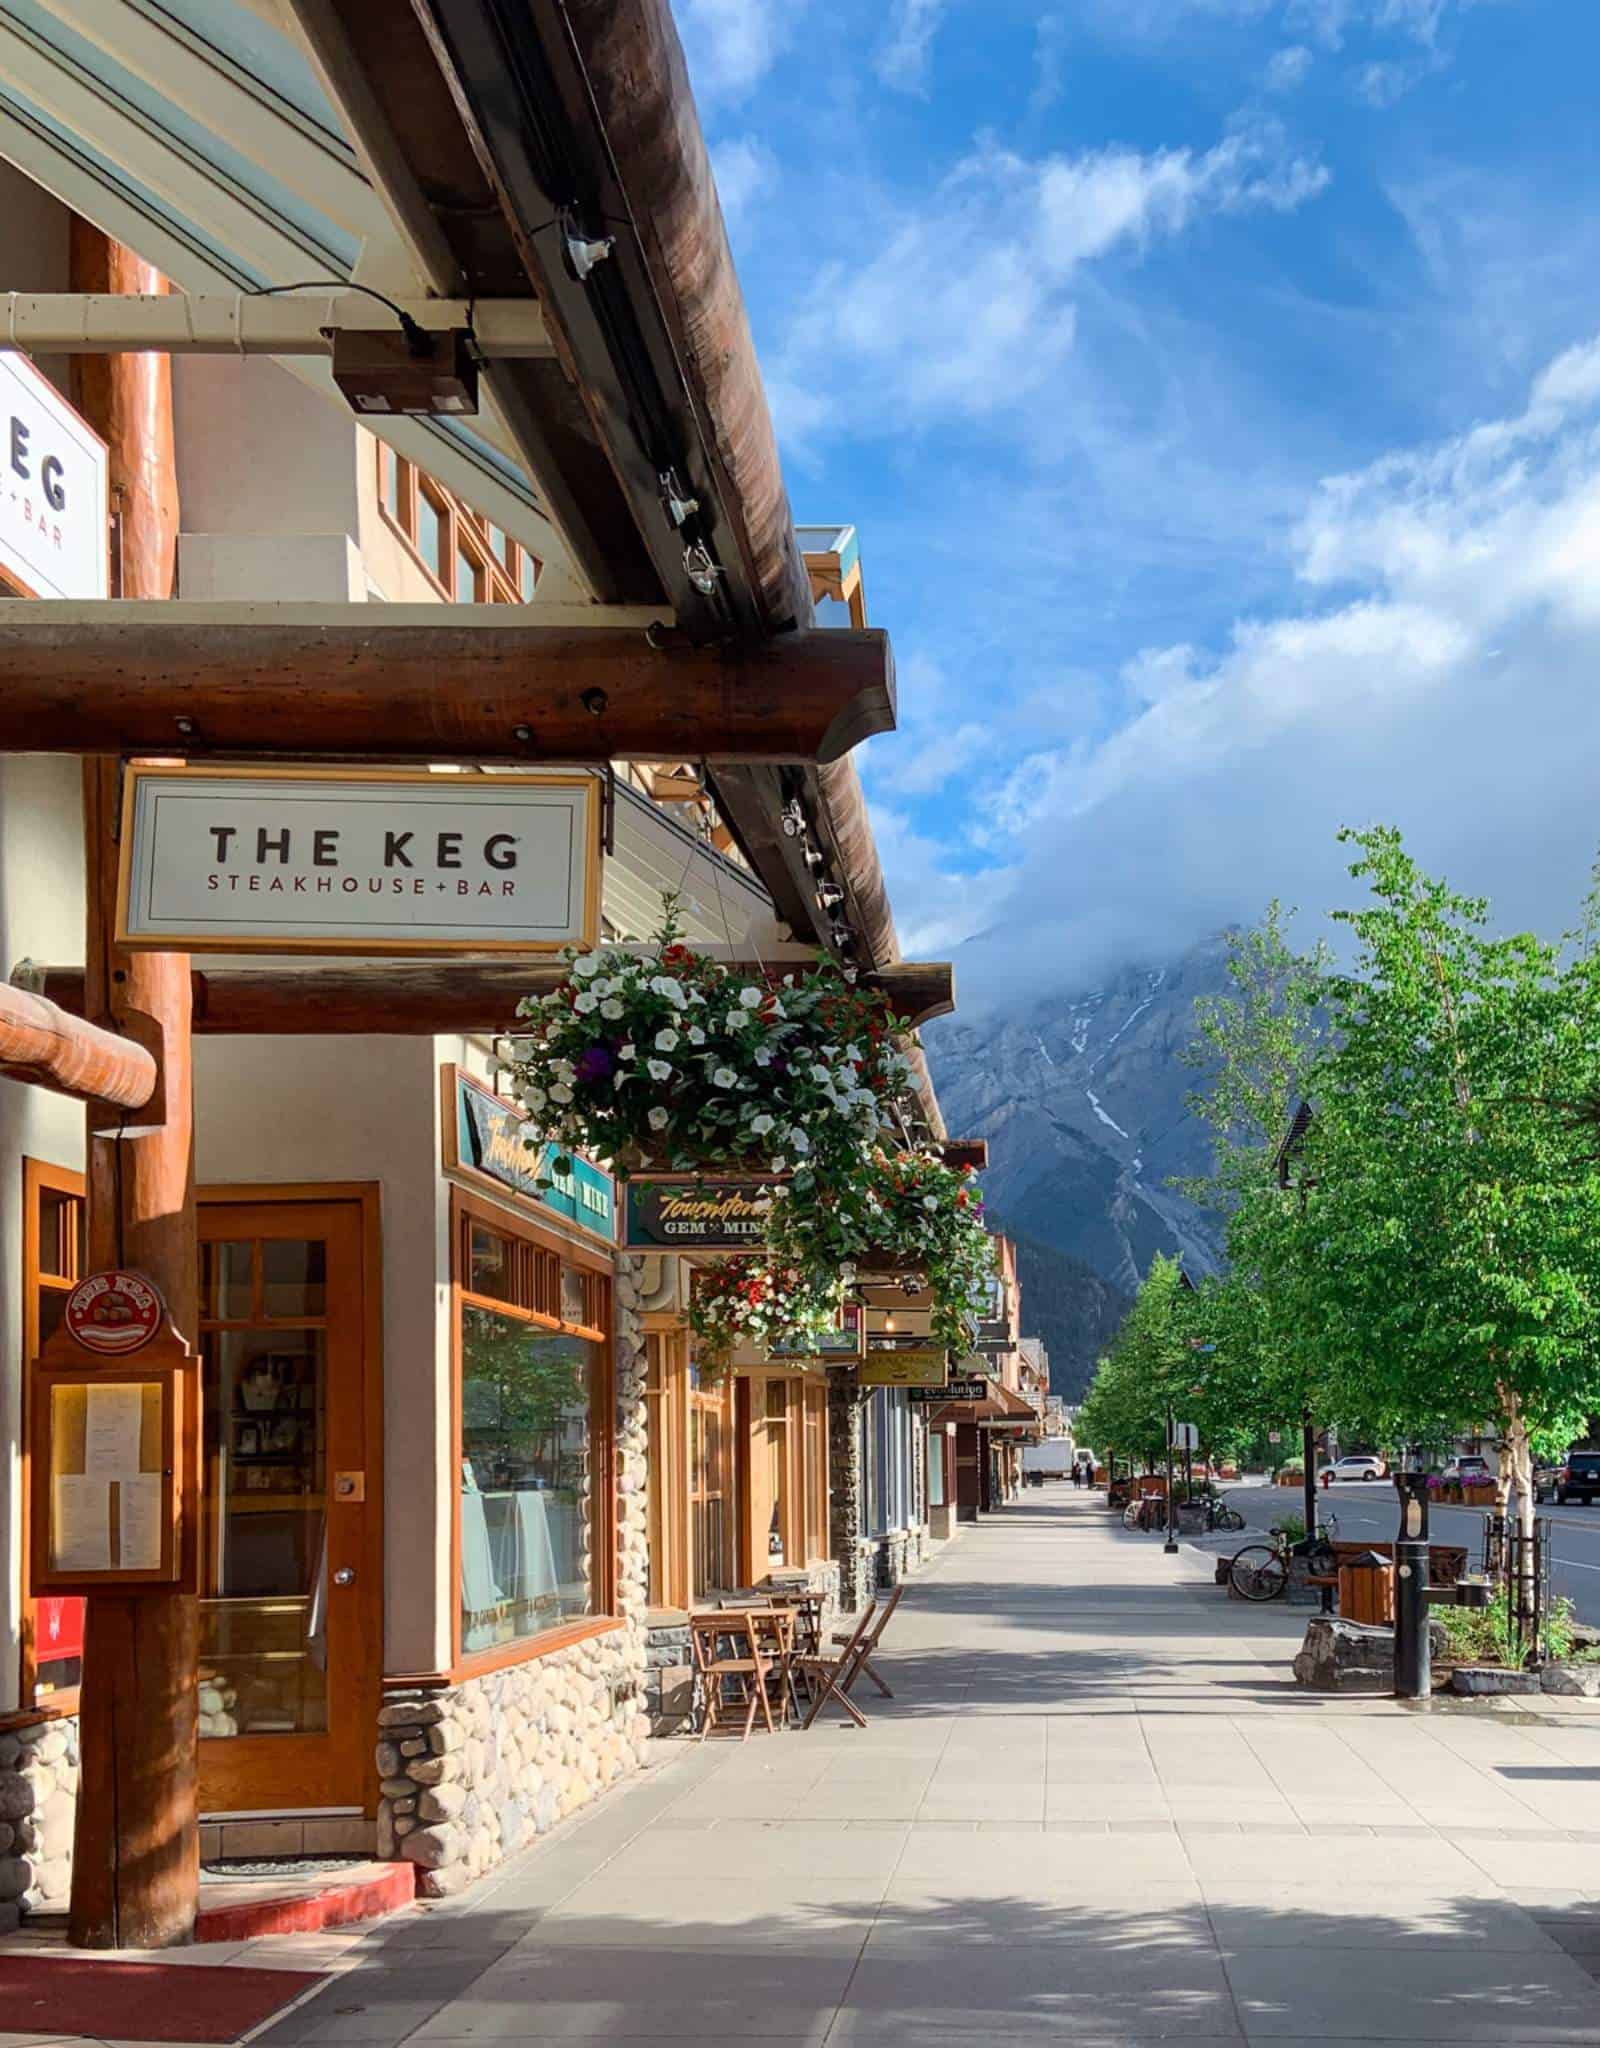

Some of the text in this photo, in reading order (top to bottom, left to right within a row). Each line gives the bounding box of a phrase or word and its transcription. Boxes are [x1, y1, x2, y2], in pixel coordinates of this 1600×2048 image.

[10, 415, 65, 512] EG
[209, 827, 518, 870] THE KEG
[663, 1221, 762, 1235] GEM MIN
